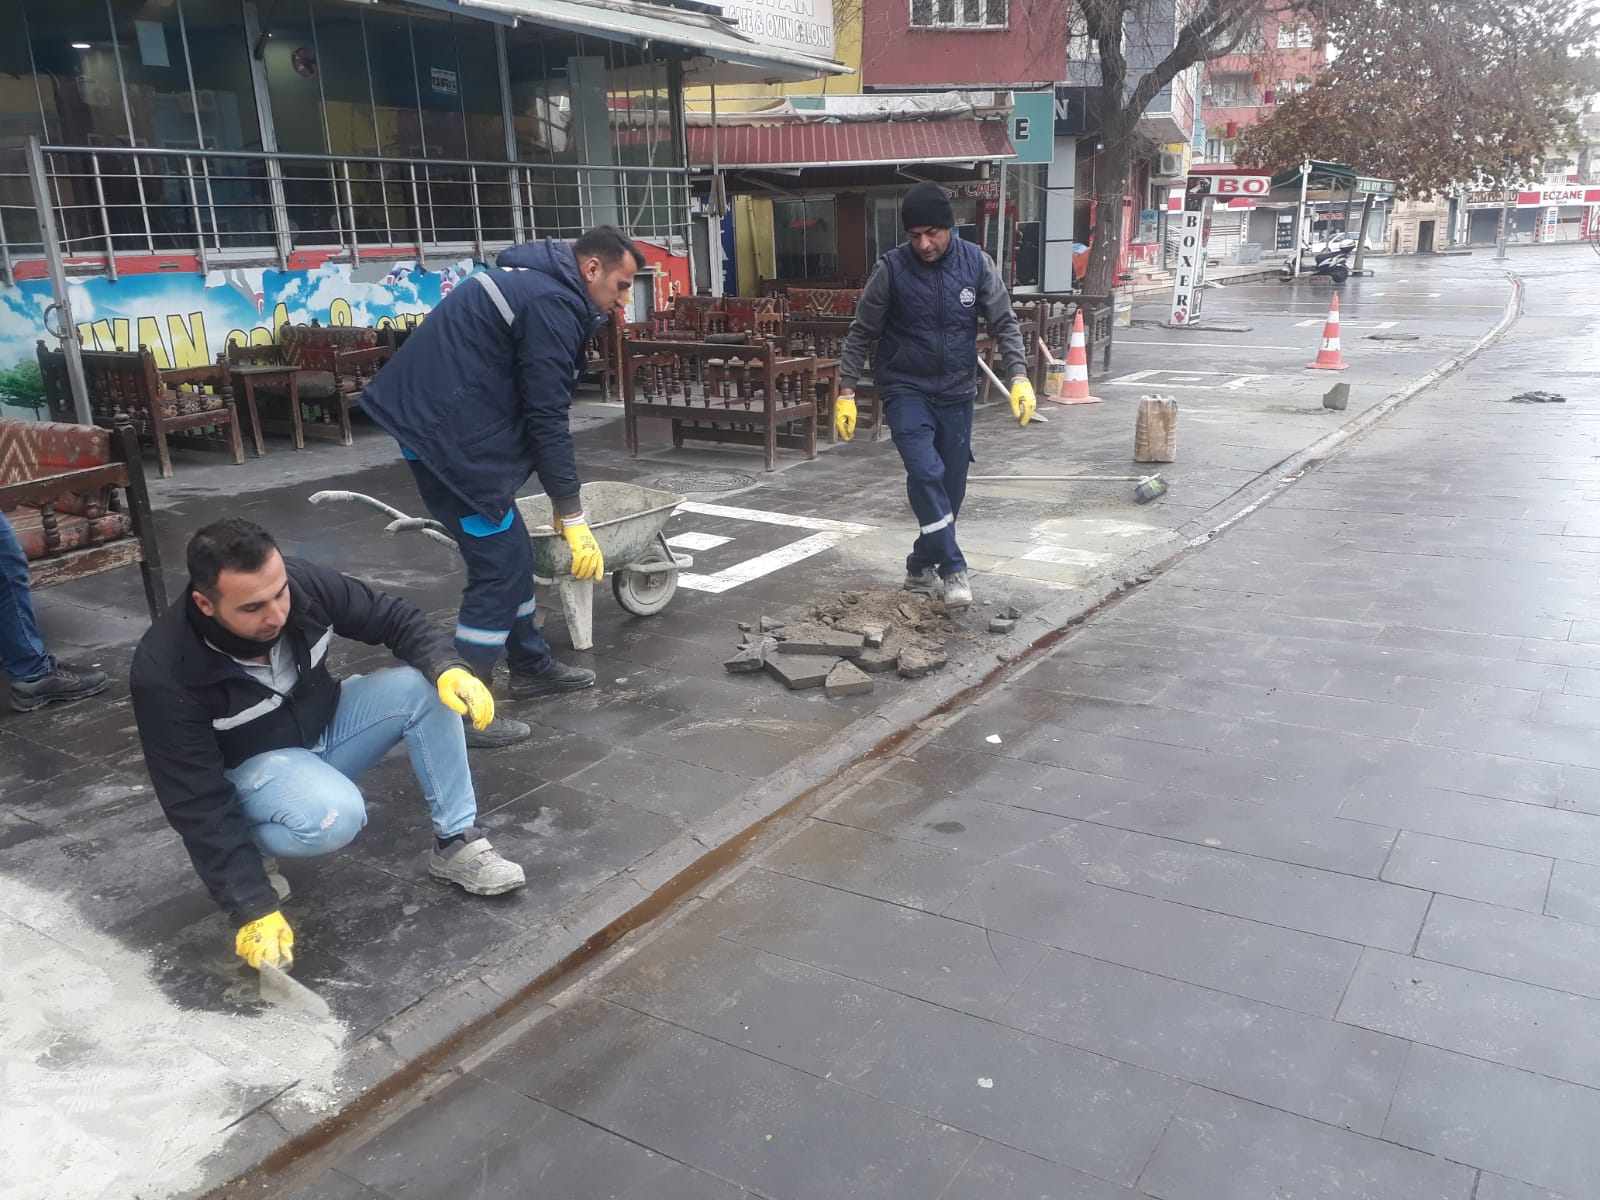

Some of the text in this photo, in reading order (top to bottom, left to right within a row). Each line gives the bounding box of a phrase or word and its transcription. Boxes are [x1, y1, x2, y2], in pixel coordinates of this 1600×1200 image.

[728, 4, 753, 33] CAFE
[755, 9, 765, 35] &
[766, 12, 794, 41] OYUN
[794, 19, 831, 48] SALONU
[1543, 190, 1583, 201] ECZANE
[1176, 215, 1198, 307] BOXER
